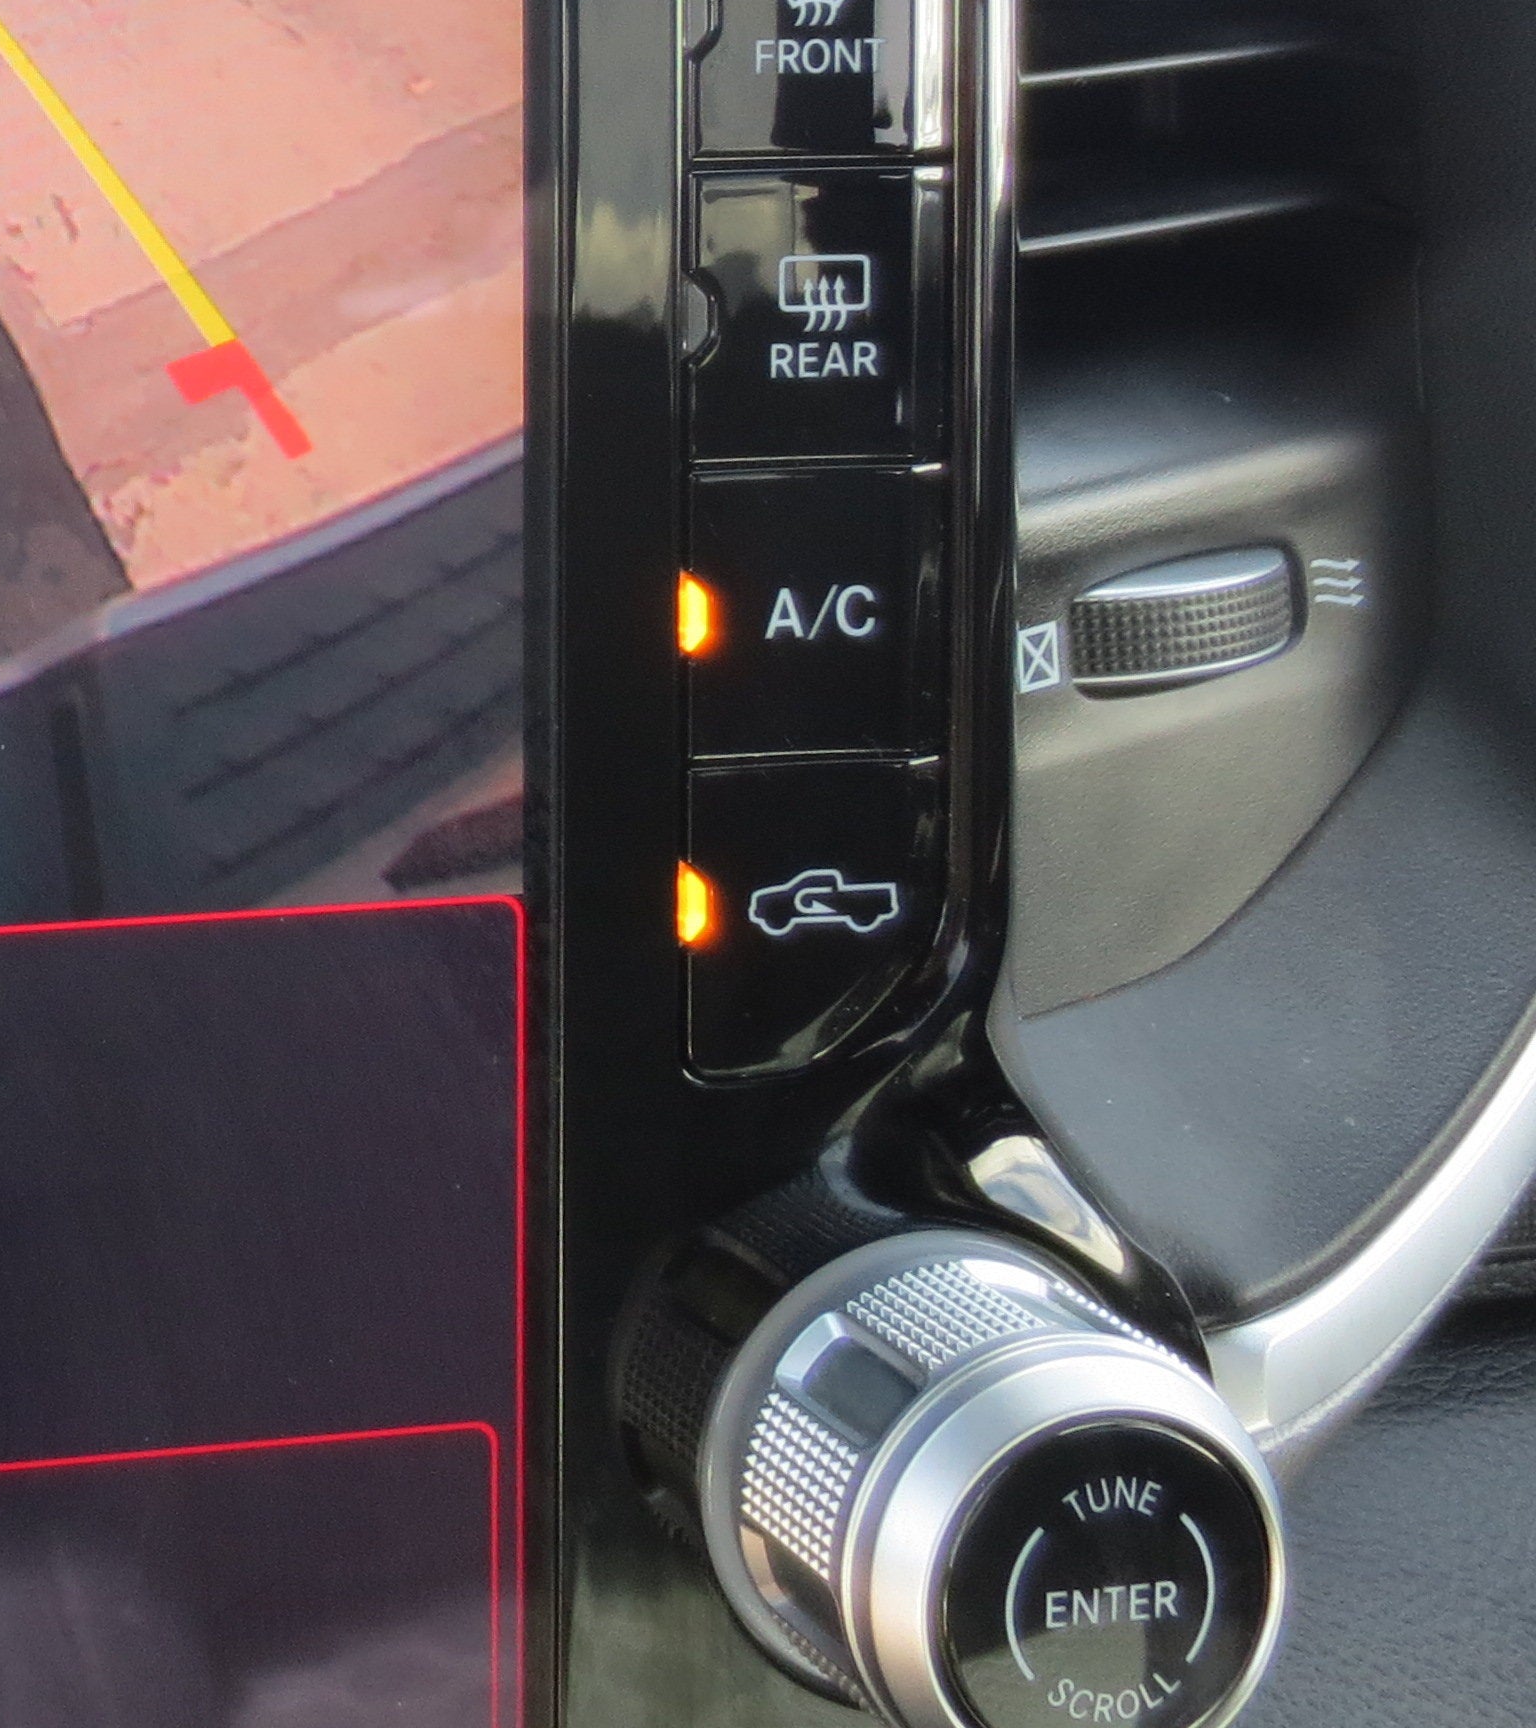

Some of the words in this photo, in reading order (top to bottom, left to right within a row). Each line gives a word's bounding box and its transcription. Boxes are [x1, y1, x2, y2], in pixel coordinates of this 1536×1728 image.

[755, 38, 886, 74] FRONT
[770, 341, 879, 378] REAR
[764, 584, 876, 640] A/C
[1062, 1476, 1162, 1521] TUNE
[1045, 1580, 1178, 1629] ENTER
[1048, 1673, 1181, 1722] SCROLL
